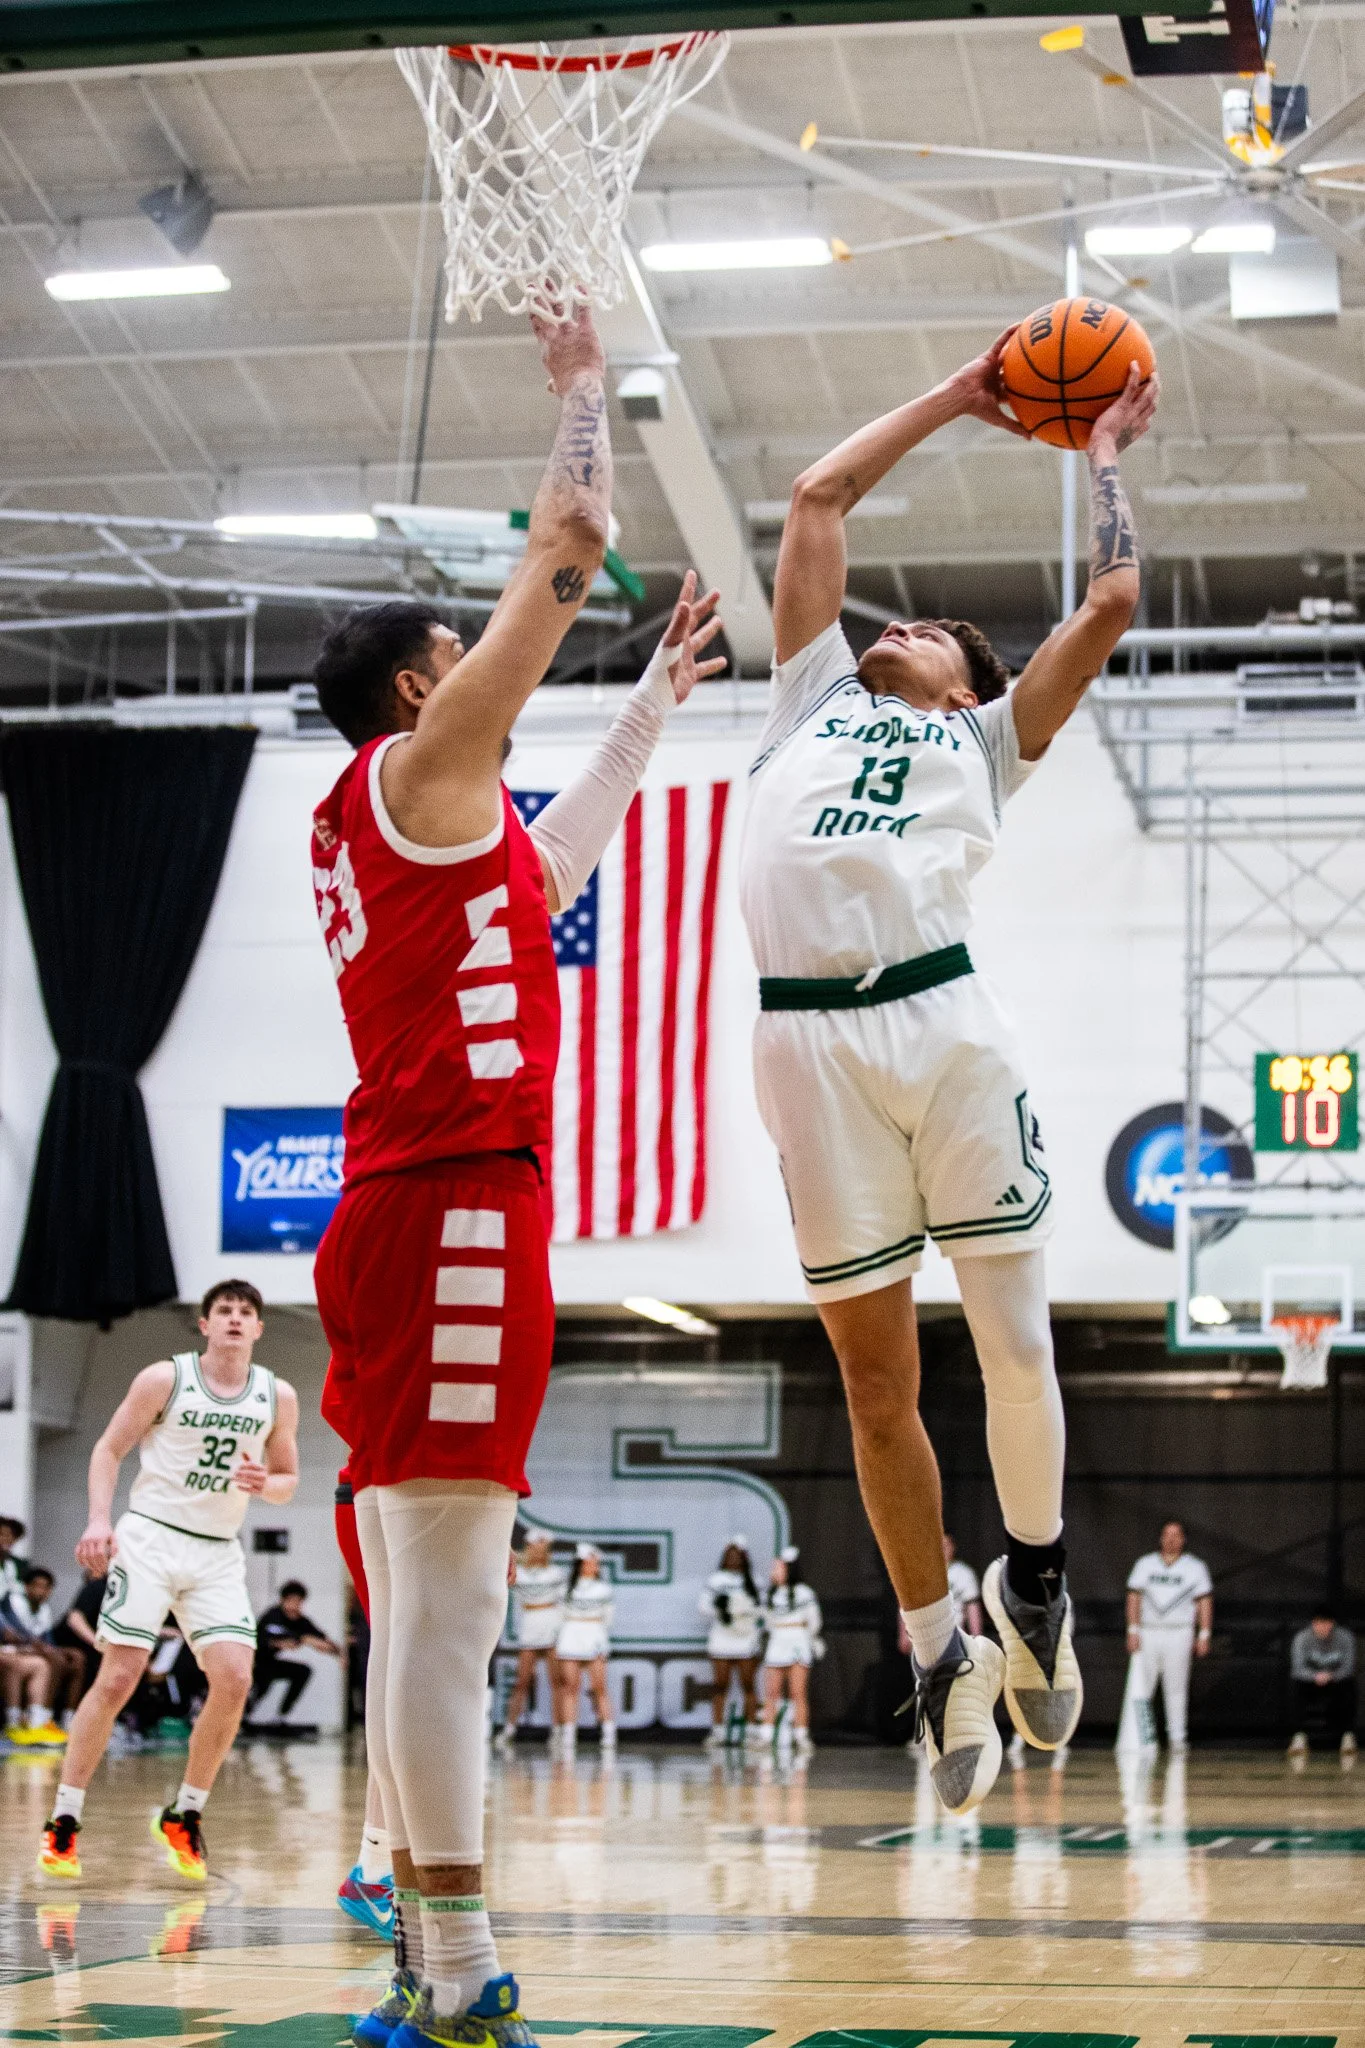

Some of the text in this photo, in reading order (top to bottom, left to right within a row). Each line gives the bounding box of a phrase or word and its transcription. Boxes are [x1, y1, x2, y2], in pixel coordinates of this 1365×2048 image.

[851, 756, 911, 806] 13
[812, 807, 922, 839] ROCK
[1282, 1090, 1341, 1149] 10
[231, 1141, 346, 1201] YOURS
[178, 1410, 266, 1436] SLIPPERY
[198, 1435, 238, 1471] 32
[185, 1471, 232, 1494] ROCK
